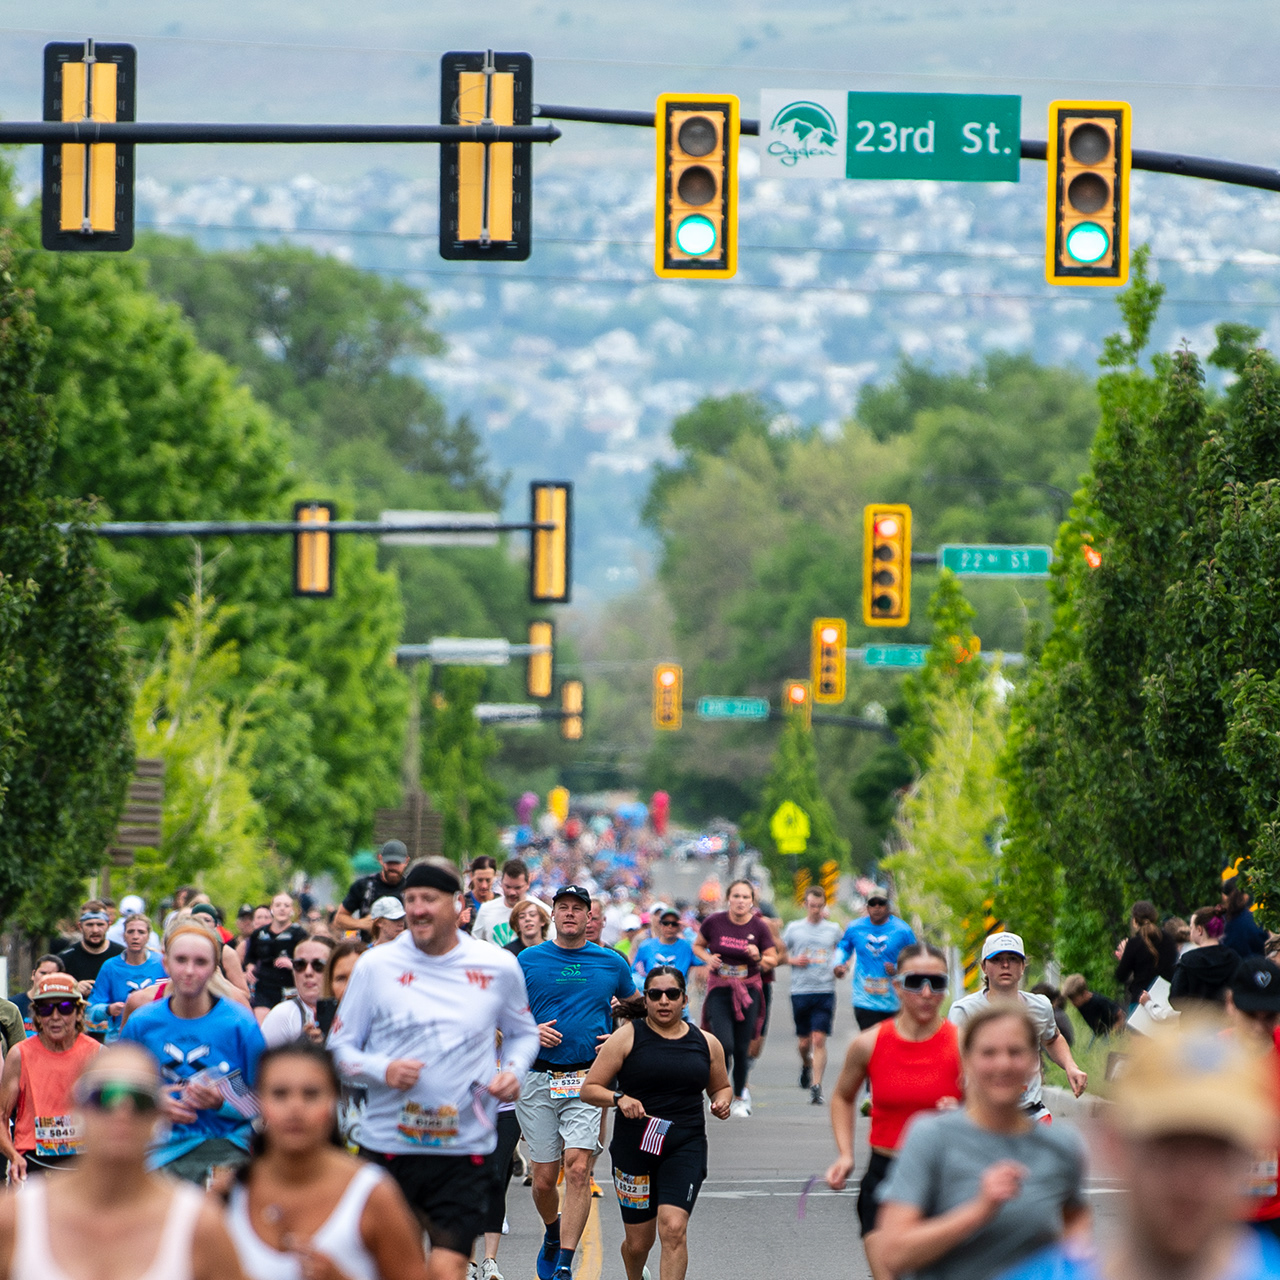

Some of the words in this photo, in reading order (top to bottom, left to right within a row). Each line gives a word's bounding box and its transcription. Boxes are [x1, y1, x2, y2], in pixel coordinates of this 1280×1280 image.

[854, 119, 936, 154] 23rd
[961, 121, 1013, 155] St.
[767, 140, 838, 168] Ogden
[561, 1078, 581, 1086] 5325
[49, 1127, 76, 1138] 5849
